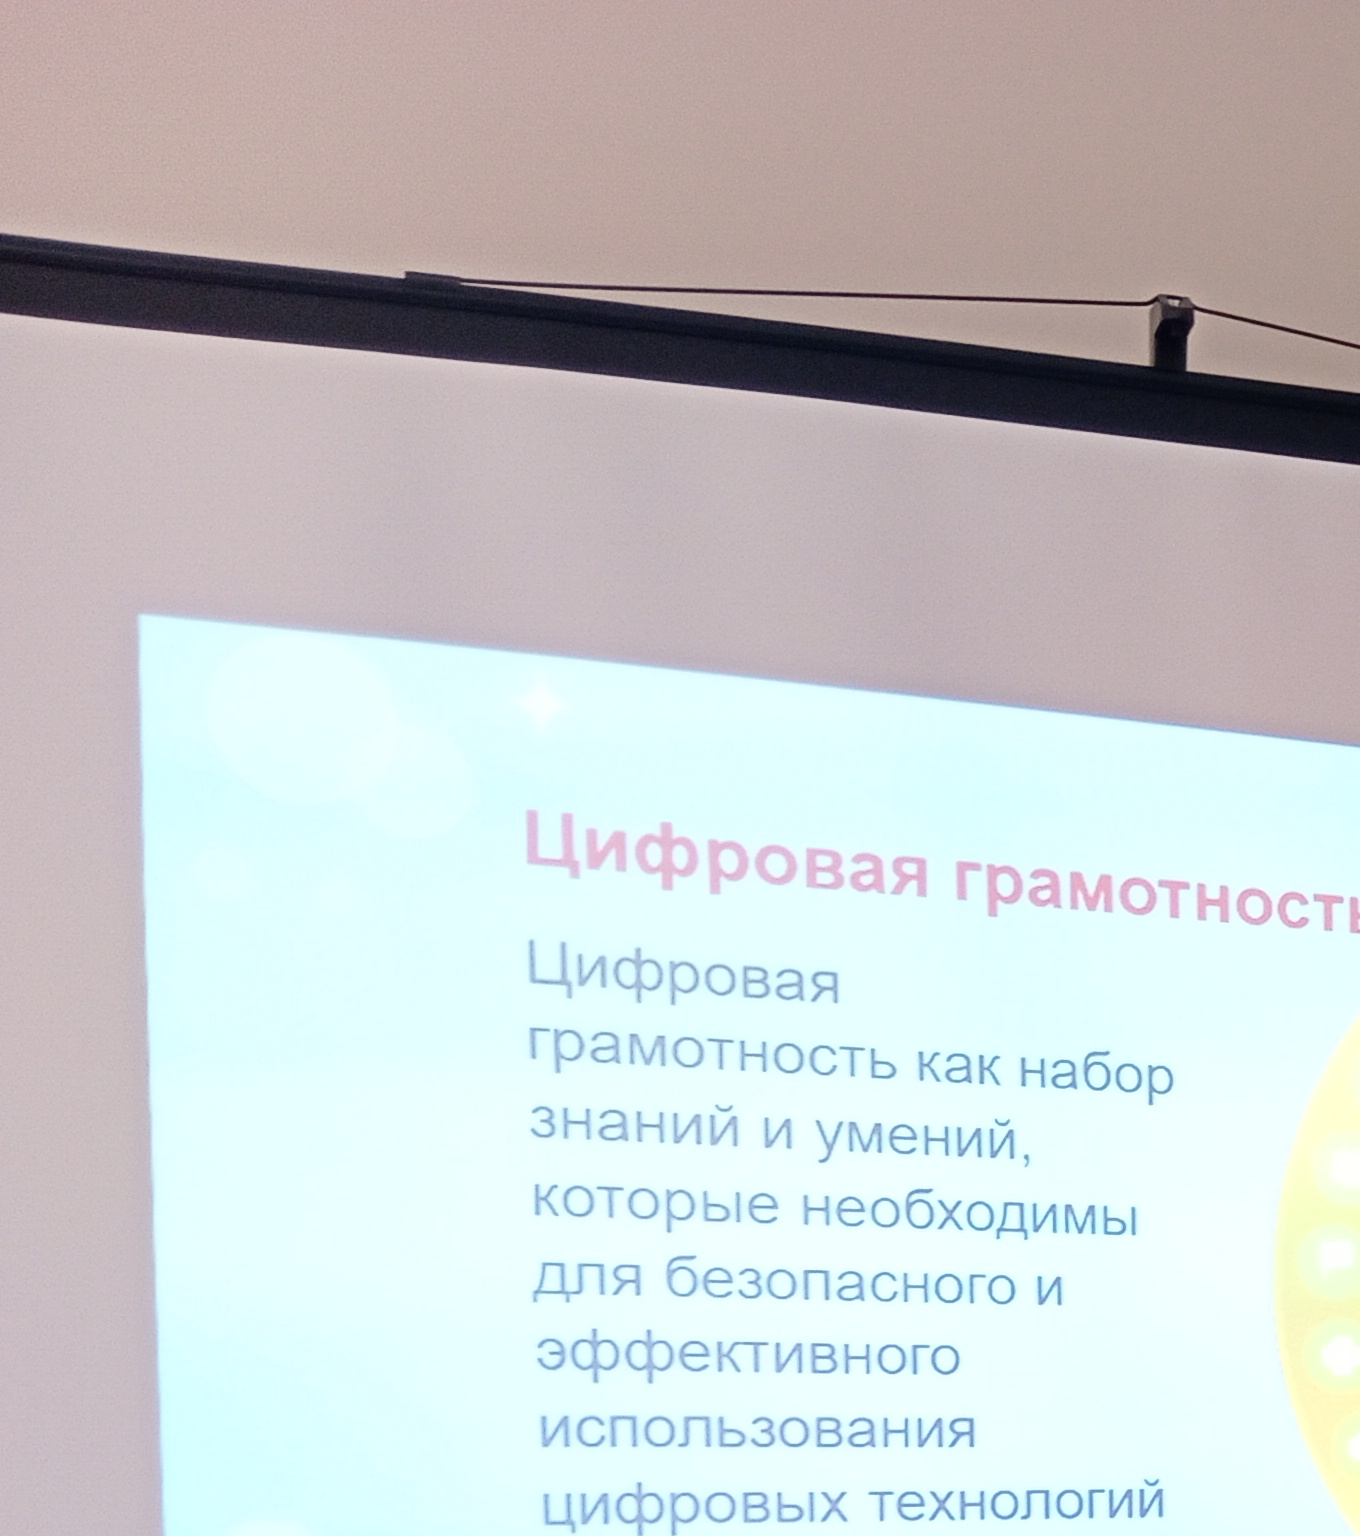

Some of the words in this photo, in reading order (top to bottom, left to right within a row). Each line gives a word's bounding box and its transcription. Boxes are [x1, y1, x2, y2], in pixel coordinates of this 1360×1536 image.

[525, 808, 929, 899] Цифровая
[527, 938, 840, 1007] Цифровая
[528, 1026, 899, 1081] грамотность
[916, 1050, 1002, 1087] как
[1019, 1049, 1175, 1107] набор
[529, 1103, 739, 1148] знаний
[762, 1115, 794, 1151] и
[814, 1117, 1031, 1169] умений,
[533, 1182, 780, 1235] которые
[802, 1187, 1138, 1242] необходимы
[531, 1260, 643, 1304] для
[665, 1254, 1018, 1306] безопасного
[1035, 1274, 1064, 1307] и
[535, 1327, 962, 1386] эффективного
[539, 1414, 976, 1449] использования
[866, 1477, 1165, 1523] технологий
